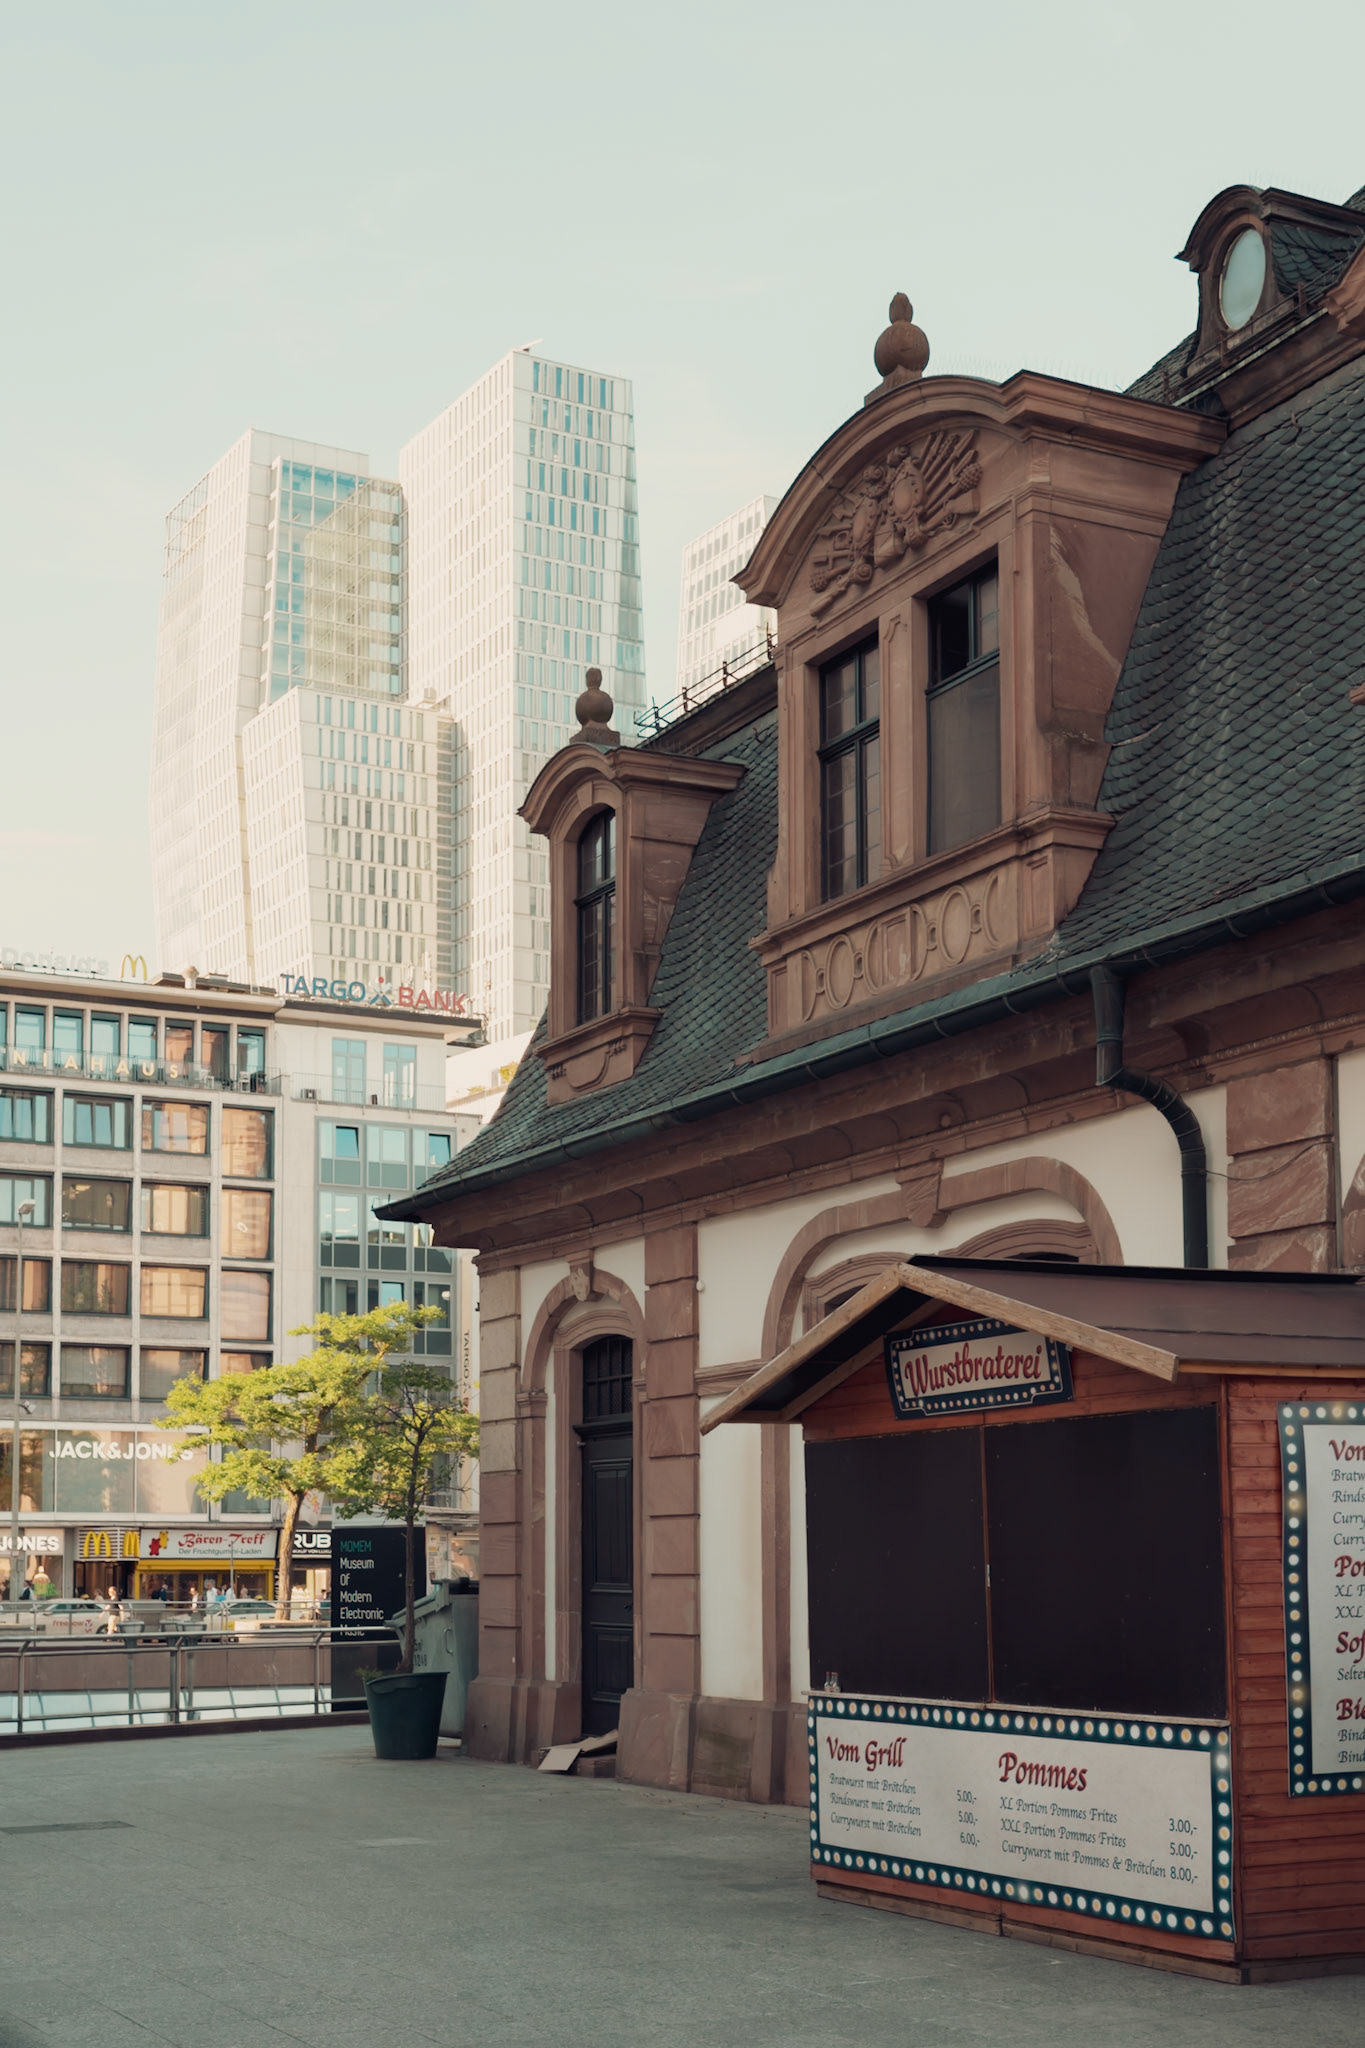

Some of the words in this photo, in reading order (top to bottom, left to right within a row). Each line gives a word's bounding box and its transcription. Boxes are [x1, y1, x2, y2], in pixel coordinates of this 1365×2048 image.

[280, 974, 366, 1002] TARGO
[398, 986, 467, 1014] BANK
[13, 1050, 179, 1079] NIAHAUS
[905, 1342, 1043, 1396] Wurstbraterei
[178, 1533, 266, 1547] Bären-Treff
[340, 1540, 372, 1552] MOMEM
[340, 1557, 375, 1569] Museum
[1334, 1555, 1365, 1578] Po
[340, 1573, 350, 1586] Of
[1334, 1584, 1353, 1597] XL
[340, 1590, 372, 1603] Modern
[340, 1606, 384, 1620] Electronic
[1334, 1606, 1363, 1619] XXL
[826, 1736, 860, 1763] Vom
[865, 1737, 907, 1772] Grill
[999, 1752, 1088, 1791] Pommes
[829, 1773, 864, 1788] Bratwurst
[866, 1778, 880, 1791] mit
[881, 1778, 916, 1795] Brötchen
[830, 1792, 869, 1809] Rindswurst
[872, 1799, 884, 1811] mit
[886, 1800, 921, 1816] Brötchen
[830, 1811, 870, 1831] Currywurst
[872, 1818, 885, 1831] mit
[887, 1820, 921, 1837] Brötchen
[999, 1797, 1014, 1810] XL
[1016, 1799, 1048, 1814] Portion
[1050, 1803, 1087, 1820] Pommes
[1089, 1808, 1118, 1823] Frites
[1168, 1818, 1198, 1836] 3.00,-
[1000, 1818, 1020, 1834] XXL
[1023, 1822, 1056, 1838] Portion
[1058, 1826, 1096, 1844] Pommes
[1098, 1831, 1126, 1848] Frites
[1169, 1842, 1198, 1860] 5.00,-
[1001, 1840, 1051, 1862] Currywurst
[1054, 1848, 1069, 1862] mit
[1072, 1851, 1109, 1869] Pommes
[1112, 1859, 1122, 1870] &
[1124, 1859, 1166, 1878] Brötchen
[1169, 1866, 1199, 1885] 8.00,-
